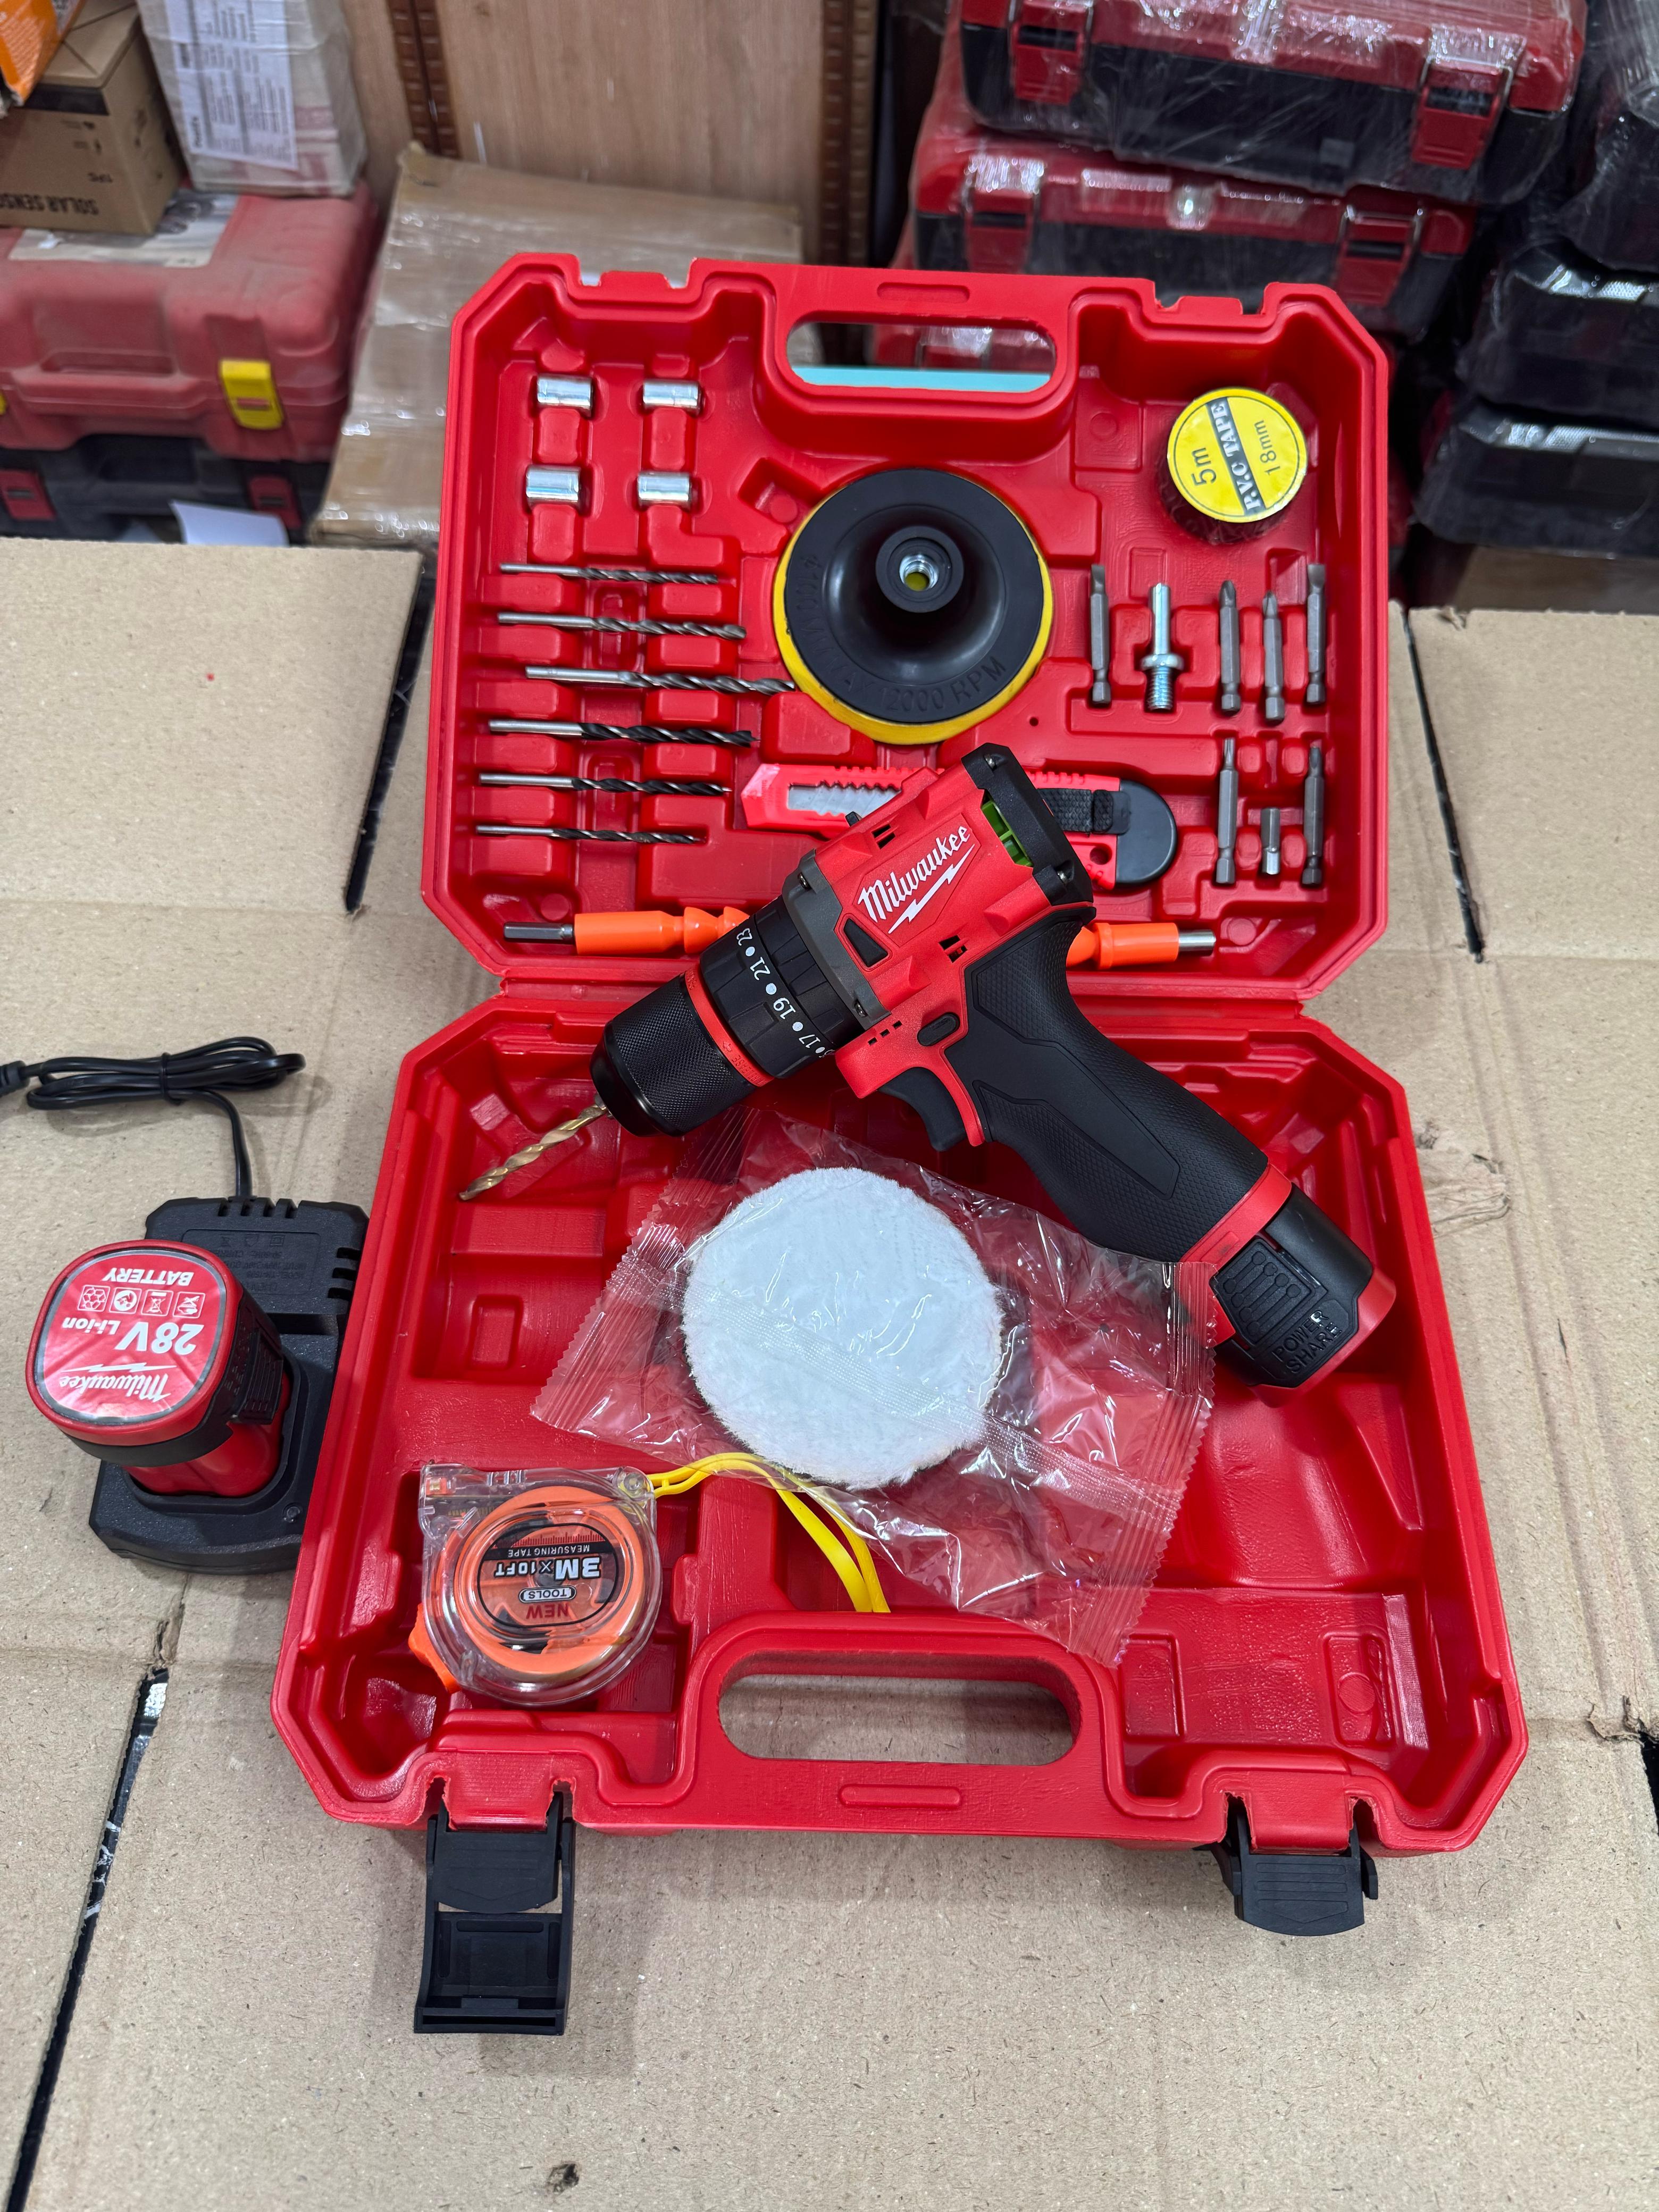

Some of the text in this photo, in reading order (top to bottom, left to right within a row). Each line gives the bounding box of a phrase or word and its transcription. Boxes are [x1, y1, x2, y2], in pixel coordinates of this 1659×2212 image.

[1210, 403, 1239, 457] TAPE
[1254, 420, 1280, 476] 18mm
[1191, 447, 1217, 486] 5m
[950, 655, 1007, 703] RPM
[857, 826, 970, 923] Milwaukee
[736, 928, 752, 946] 23
[750, 957, 770, 981] 21
[773, 998, 796, 1020] 19
[799, 1034, 820, 1048] 17
[102, 1267, 195, 1286] BATTERY
[62, 1317, 205, 1355] 28V Li-ion
[1271, 1310, 1329, 1362] POWER
[1286, 1321, 1343, 1373] SHARE
[59, 1373, 172, 1403] Milwaukee
[534, 1544, 590, 1556] MEASURING
[527, 1589, 567, 1599] TOOLS
[526, 1603, 569, 1619] NEW
